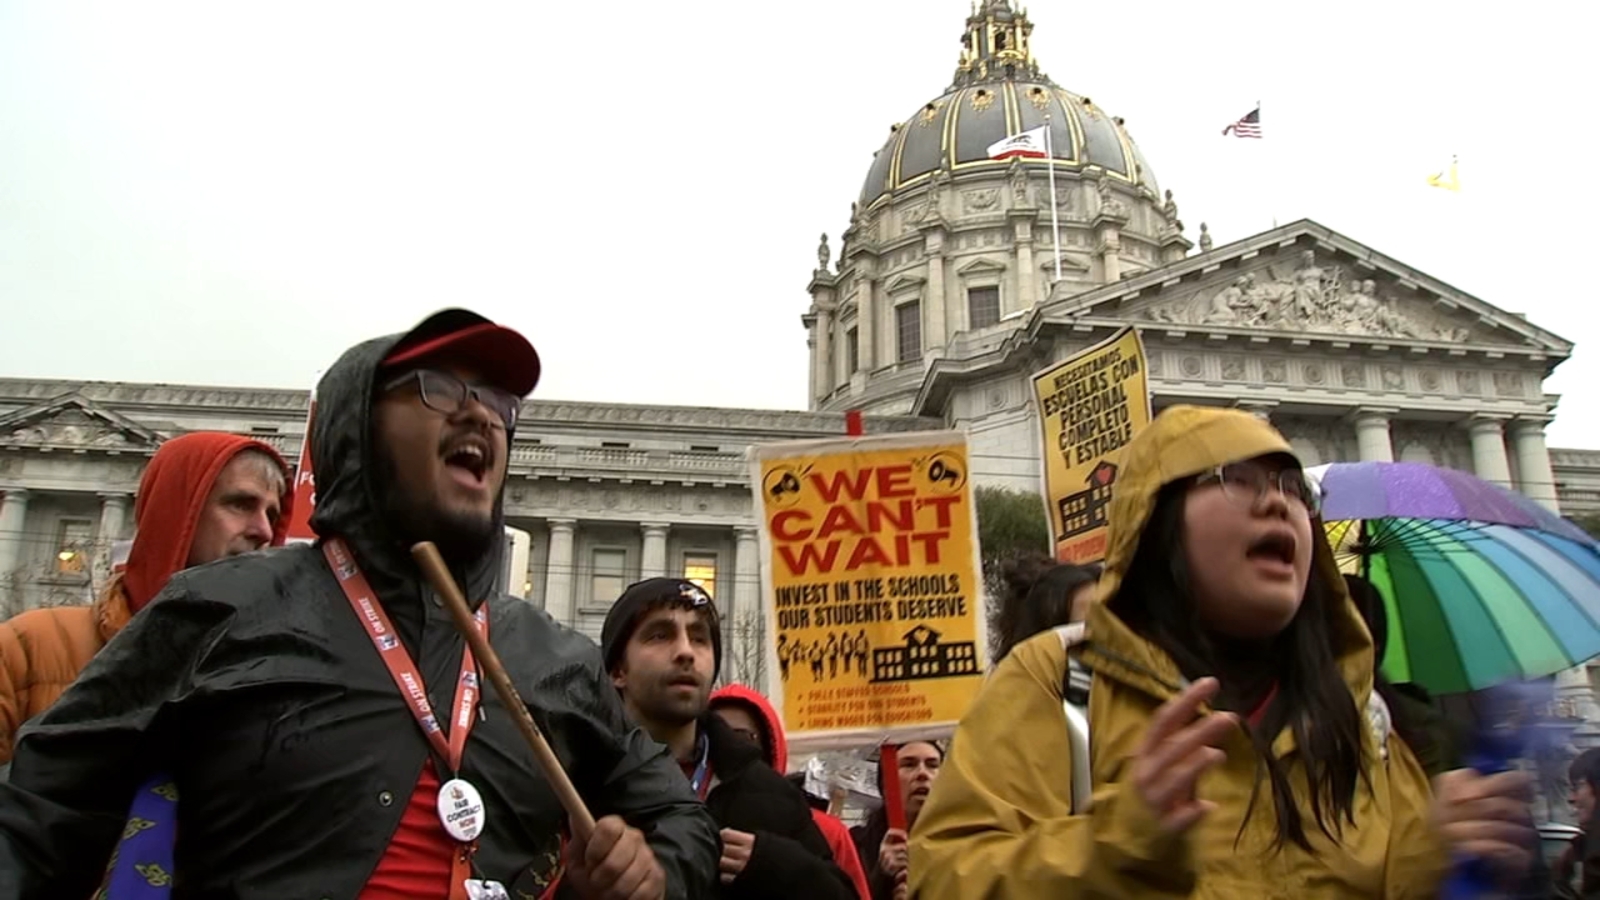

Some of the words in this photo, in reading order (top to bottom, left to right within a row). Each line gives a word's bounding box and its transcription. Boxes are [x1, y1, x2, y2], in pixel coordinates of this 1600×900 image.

[1043, 371, 1109, 418] ESCUELAS
[1112, 354, 1139, 382] CON
[1060, 383, 1127, 430] PERSONAL
[1058, 404, 1129, 450] COMPLETO
[1062, 450, 1071, 470] Y
[1076, 422, 1132, 465] ESTABLE
[808, 463, 916, 504] WE
[770, 496, 961, 542] CAN'T
[777, 531, 949, 578] WAIT
[358, 597, 379, 622] STRIKE
[776, 584, 828, 608] INVEST
[835, 582, 851, 603] IN
[854, 579, 884, 600] THE
[888, 574, 960, 597] SCHOOLS
[370, 619, 386, 634] ON
[778, 607, 811, 631] OUR
[815, 602, 893, 628] STUDENTS
[898, 596, 967, 619] DESERVE
[400, 671, 425, 699] STRIKE
[415, 698, 431, 712] ON
